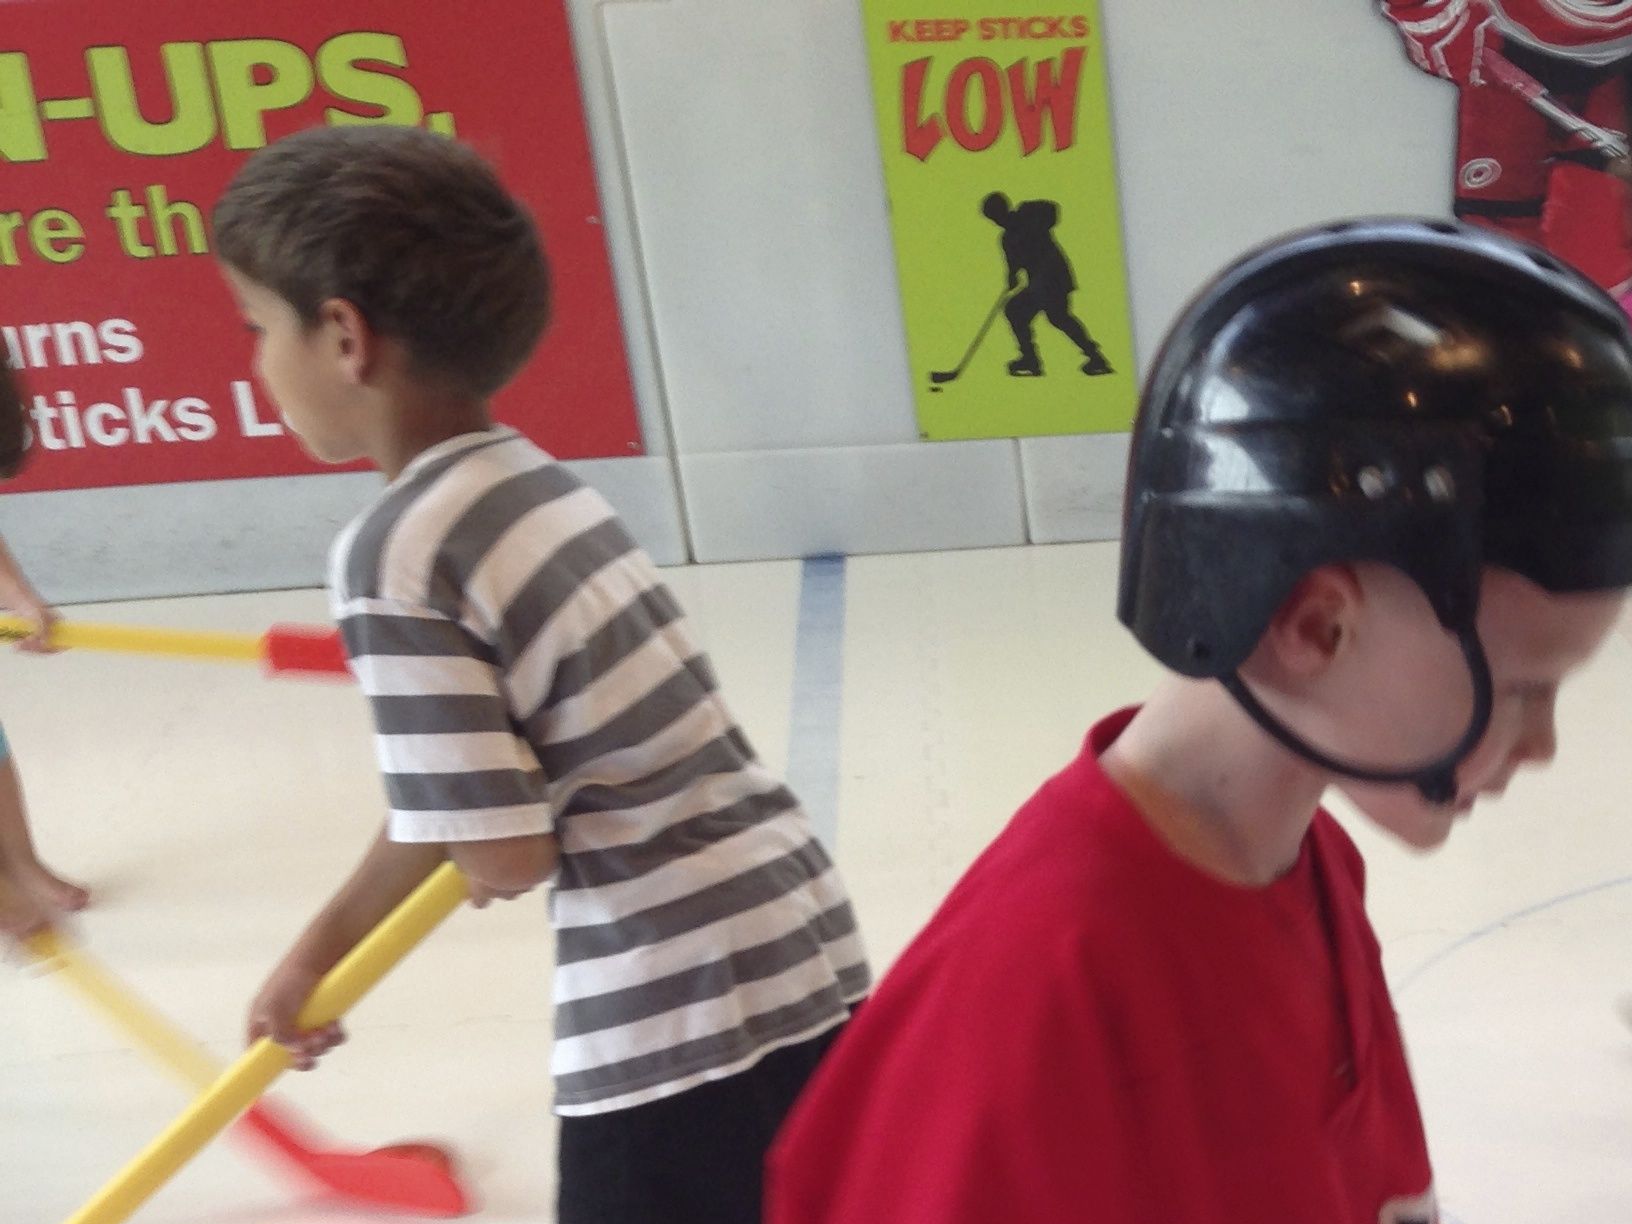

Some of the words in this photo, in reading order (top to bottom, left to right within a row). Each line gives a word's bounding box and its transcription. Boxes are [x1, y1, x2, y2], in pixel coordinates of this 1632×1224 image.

[889, 18, 969, 42] KEEP
[977, 15, 1089, 40] STICKS
[902, 46, 1087, 162] LOW
[105, 184, 209, 258] th
[230, 380, 295, 438] L
